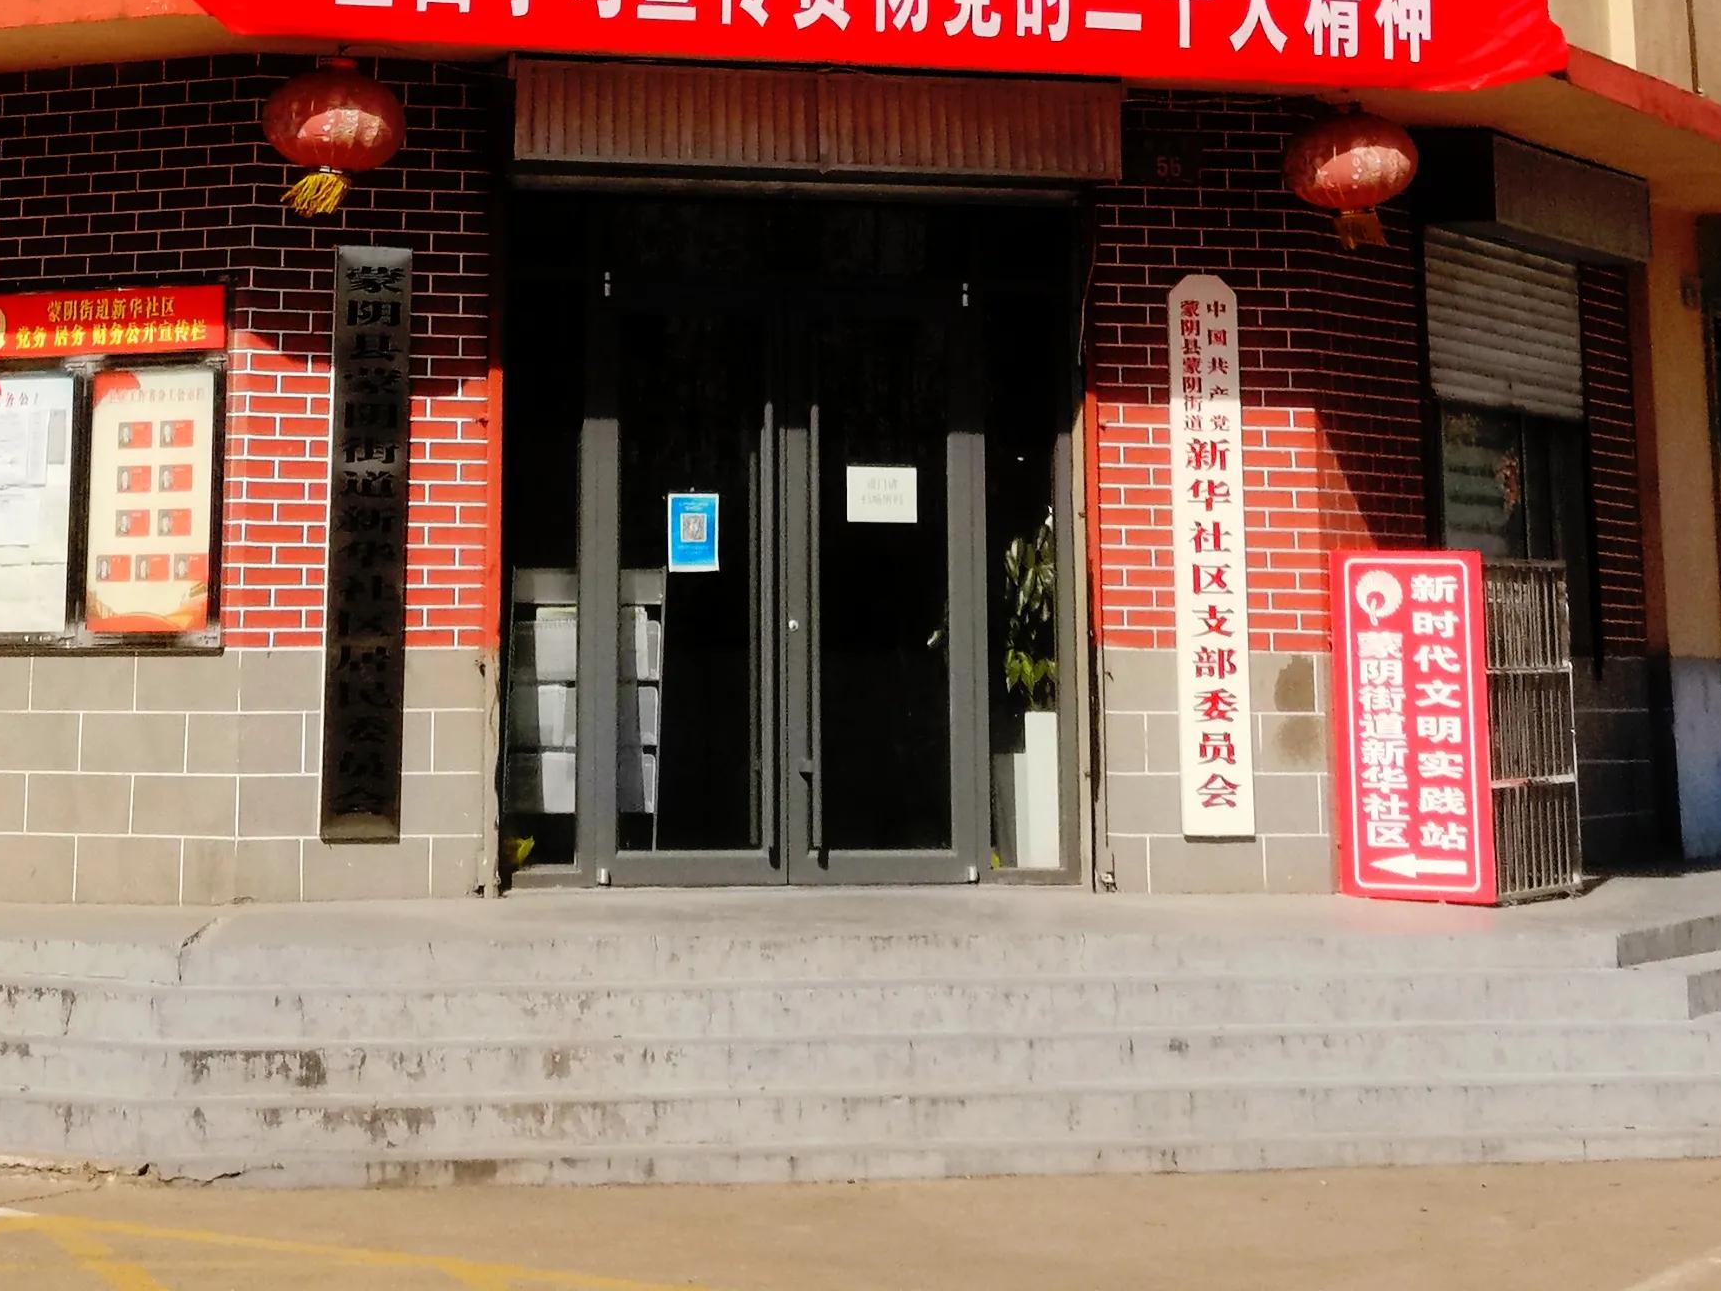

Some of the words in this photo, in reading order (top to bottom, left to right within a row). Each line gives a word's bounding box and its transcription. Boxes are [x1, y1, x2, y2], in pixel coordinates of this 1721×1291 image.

[15, 326, 47, 350] 党务
[91, 318, 207, 347] 财务公开宣传栏
[47, 295, 176, 323] 蒙阴街道新华社区
[1178, 299, 1204, 432] 蒙阴县蒙阴街道
[1205, 300, 1231, 432] 中国共产党
[1185, 437, 1242, 809] 新华社区支部委员会
[1358, 631, 1410, 849] 蒙阴街道新华社区
[1410, 573, 1468, 851] 新时代文明实践站
